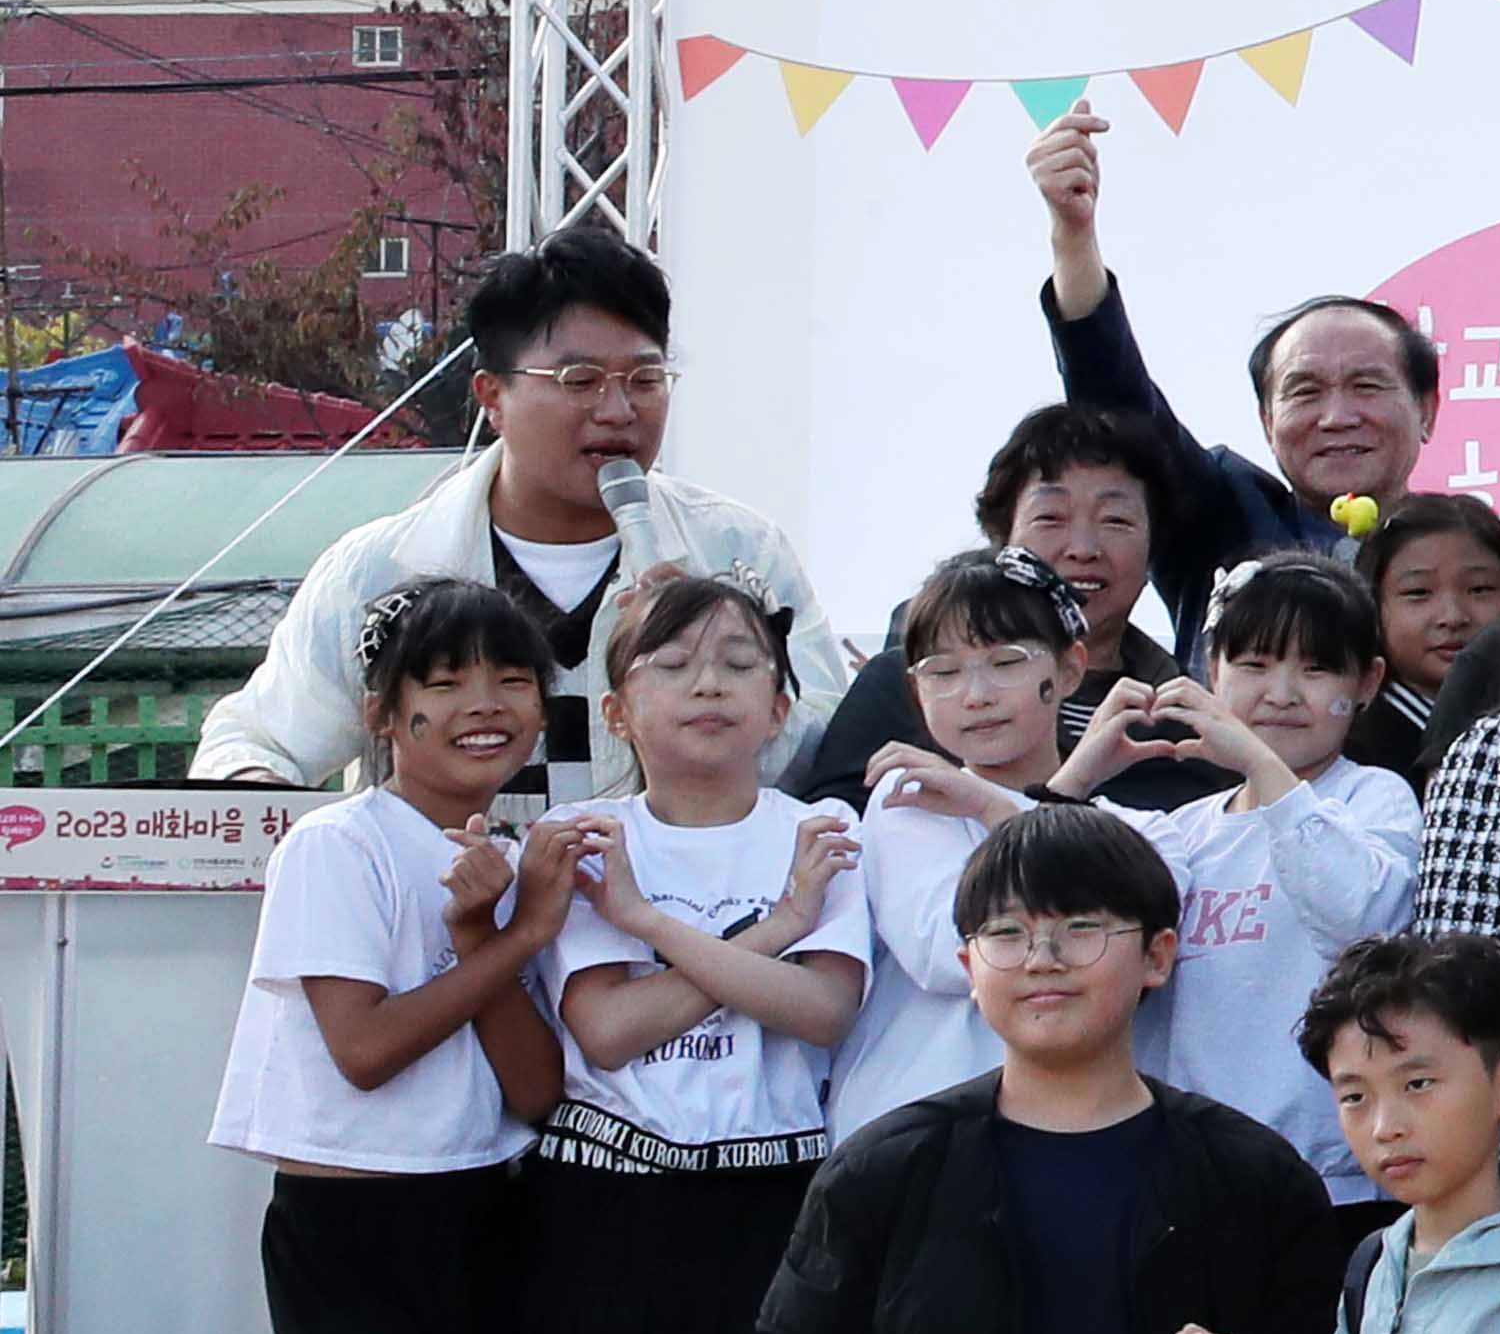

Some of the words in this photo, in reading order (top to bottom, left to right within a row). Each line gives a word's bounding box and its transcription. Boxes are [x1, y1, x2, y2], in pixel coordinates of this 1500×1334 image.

[57, 810, 127, 838] 2023
[136, 807, 245, 844] 매화마을
[629, 1133, 709, 1171] KUROMI
